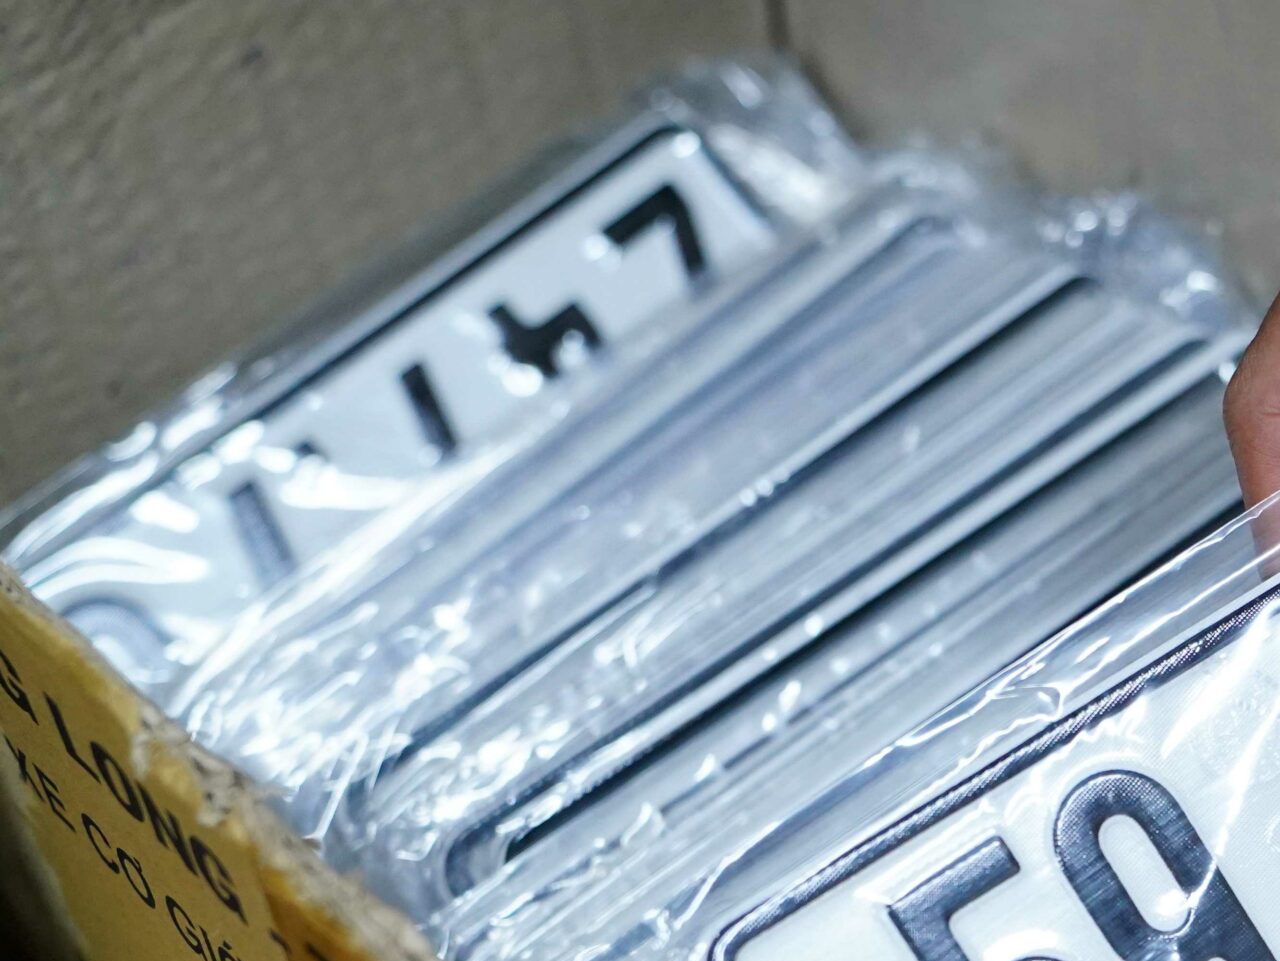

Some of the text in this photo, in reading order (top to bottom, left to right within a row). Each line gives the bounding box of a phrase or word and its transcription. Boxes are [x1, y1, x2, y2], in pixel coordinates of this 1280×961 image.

[4, 735, 77, 833] XE
[81, 813, 156, 909] CƠ
[43, 690, 246, 926] LONG
